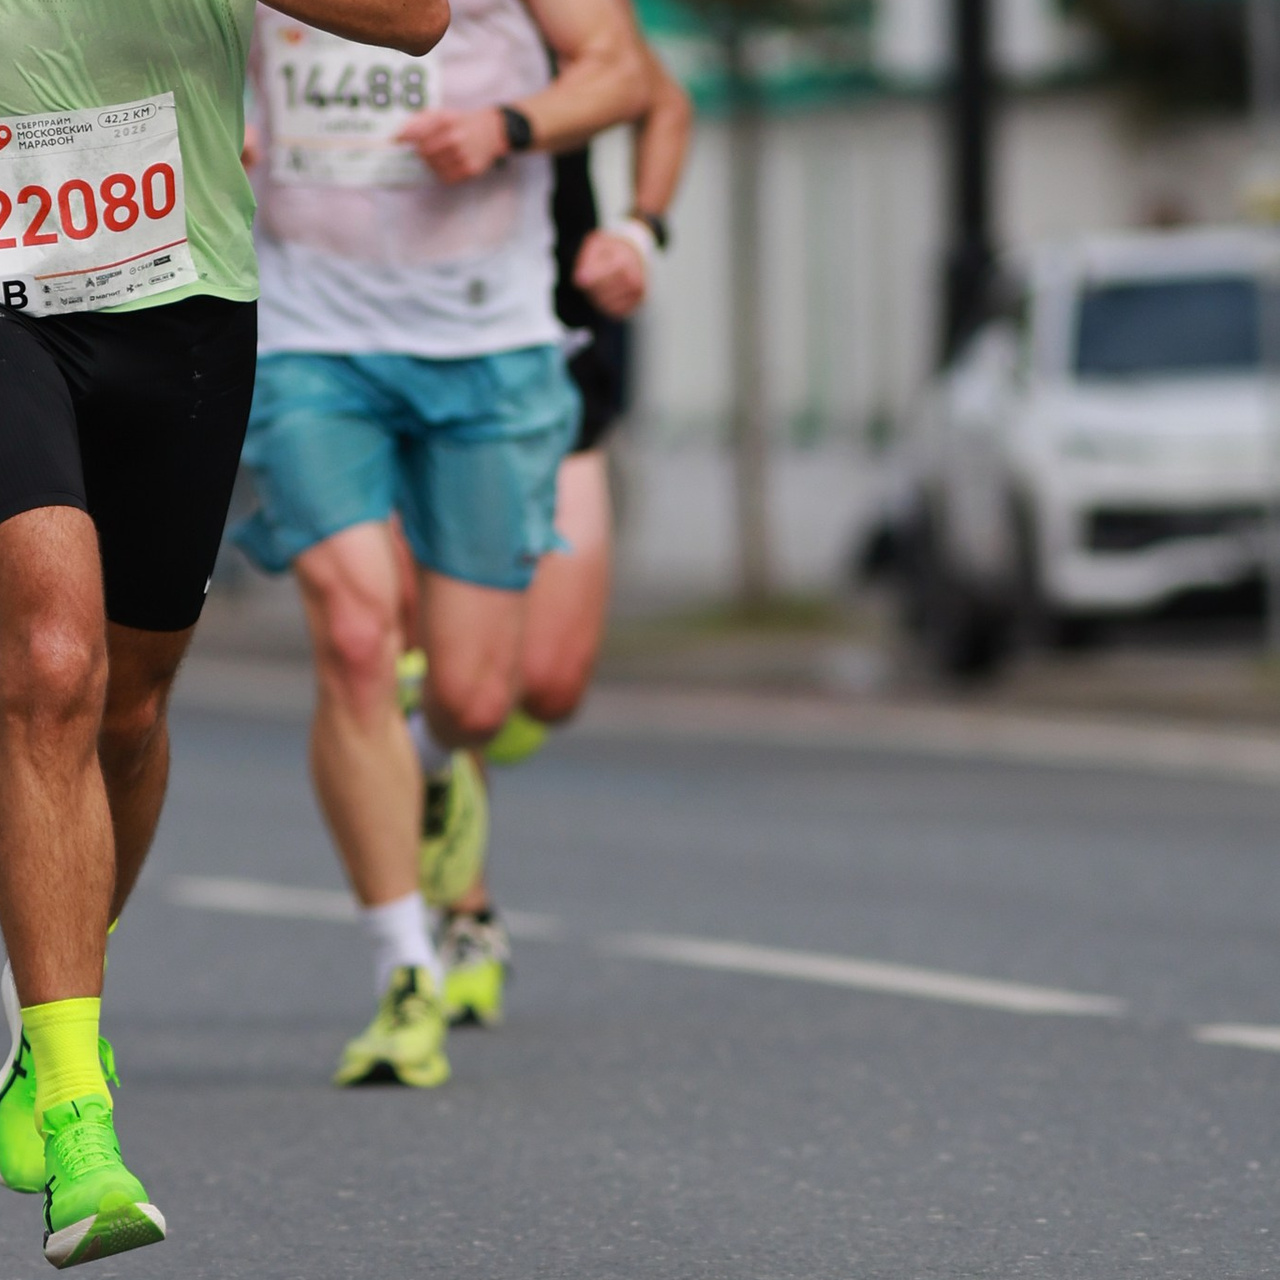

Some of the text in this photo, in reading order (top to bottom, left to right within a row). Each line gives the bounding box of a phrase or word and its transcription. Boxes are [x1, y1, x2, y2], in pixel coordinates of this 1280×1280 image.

[282, 64, 427, 111] 14488
[16, 117, 71, 130] СБЕРПРАЙМ
[104, 107, 150, 124] 42,2 КМ
[17, 123, 93, 140] МОСКОВСКИЙ
[18, 136, 74, 150] МАРАФОН
